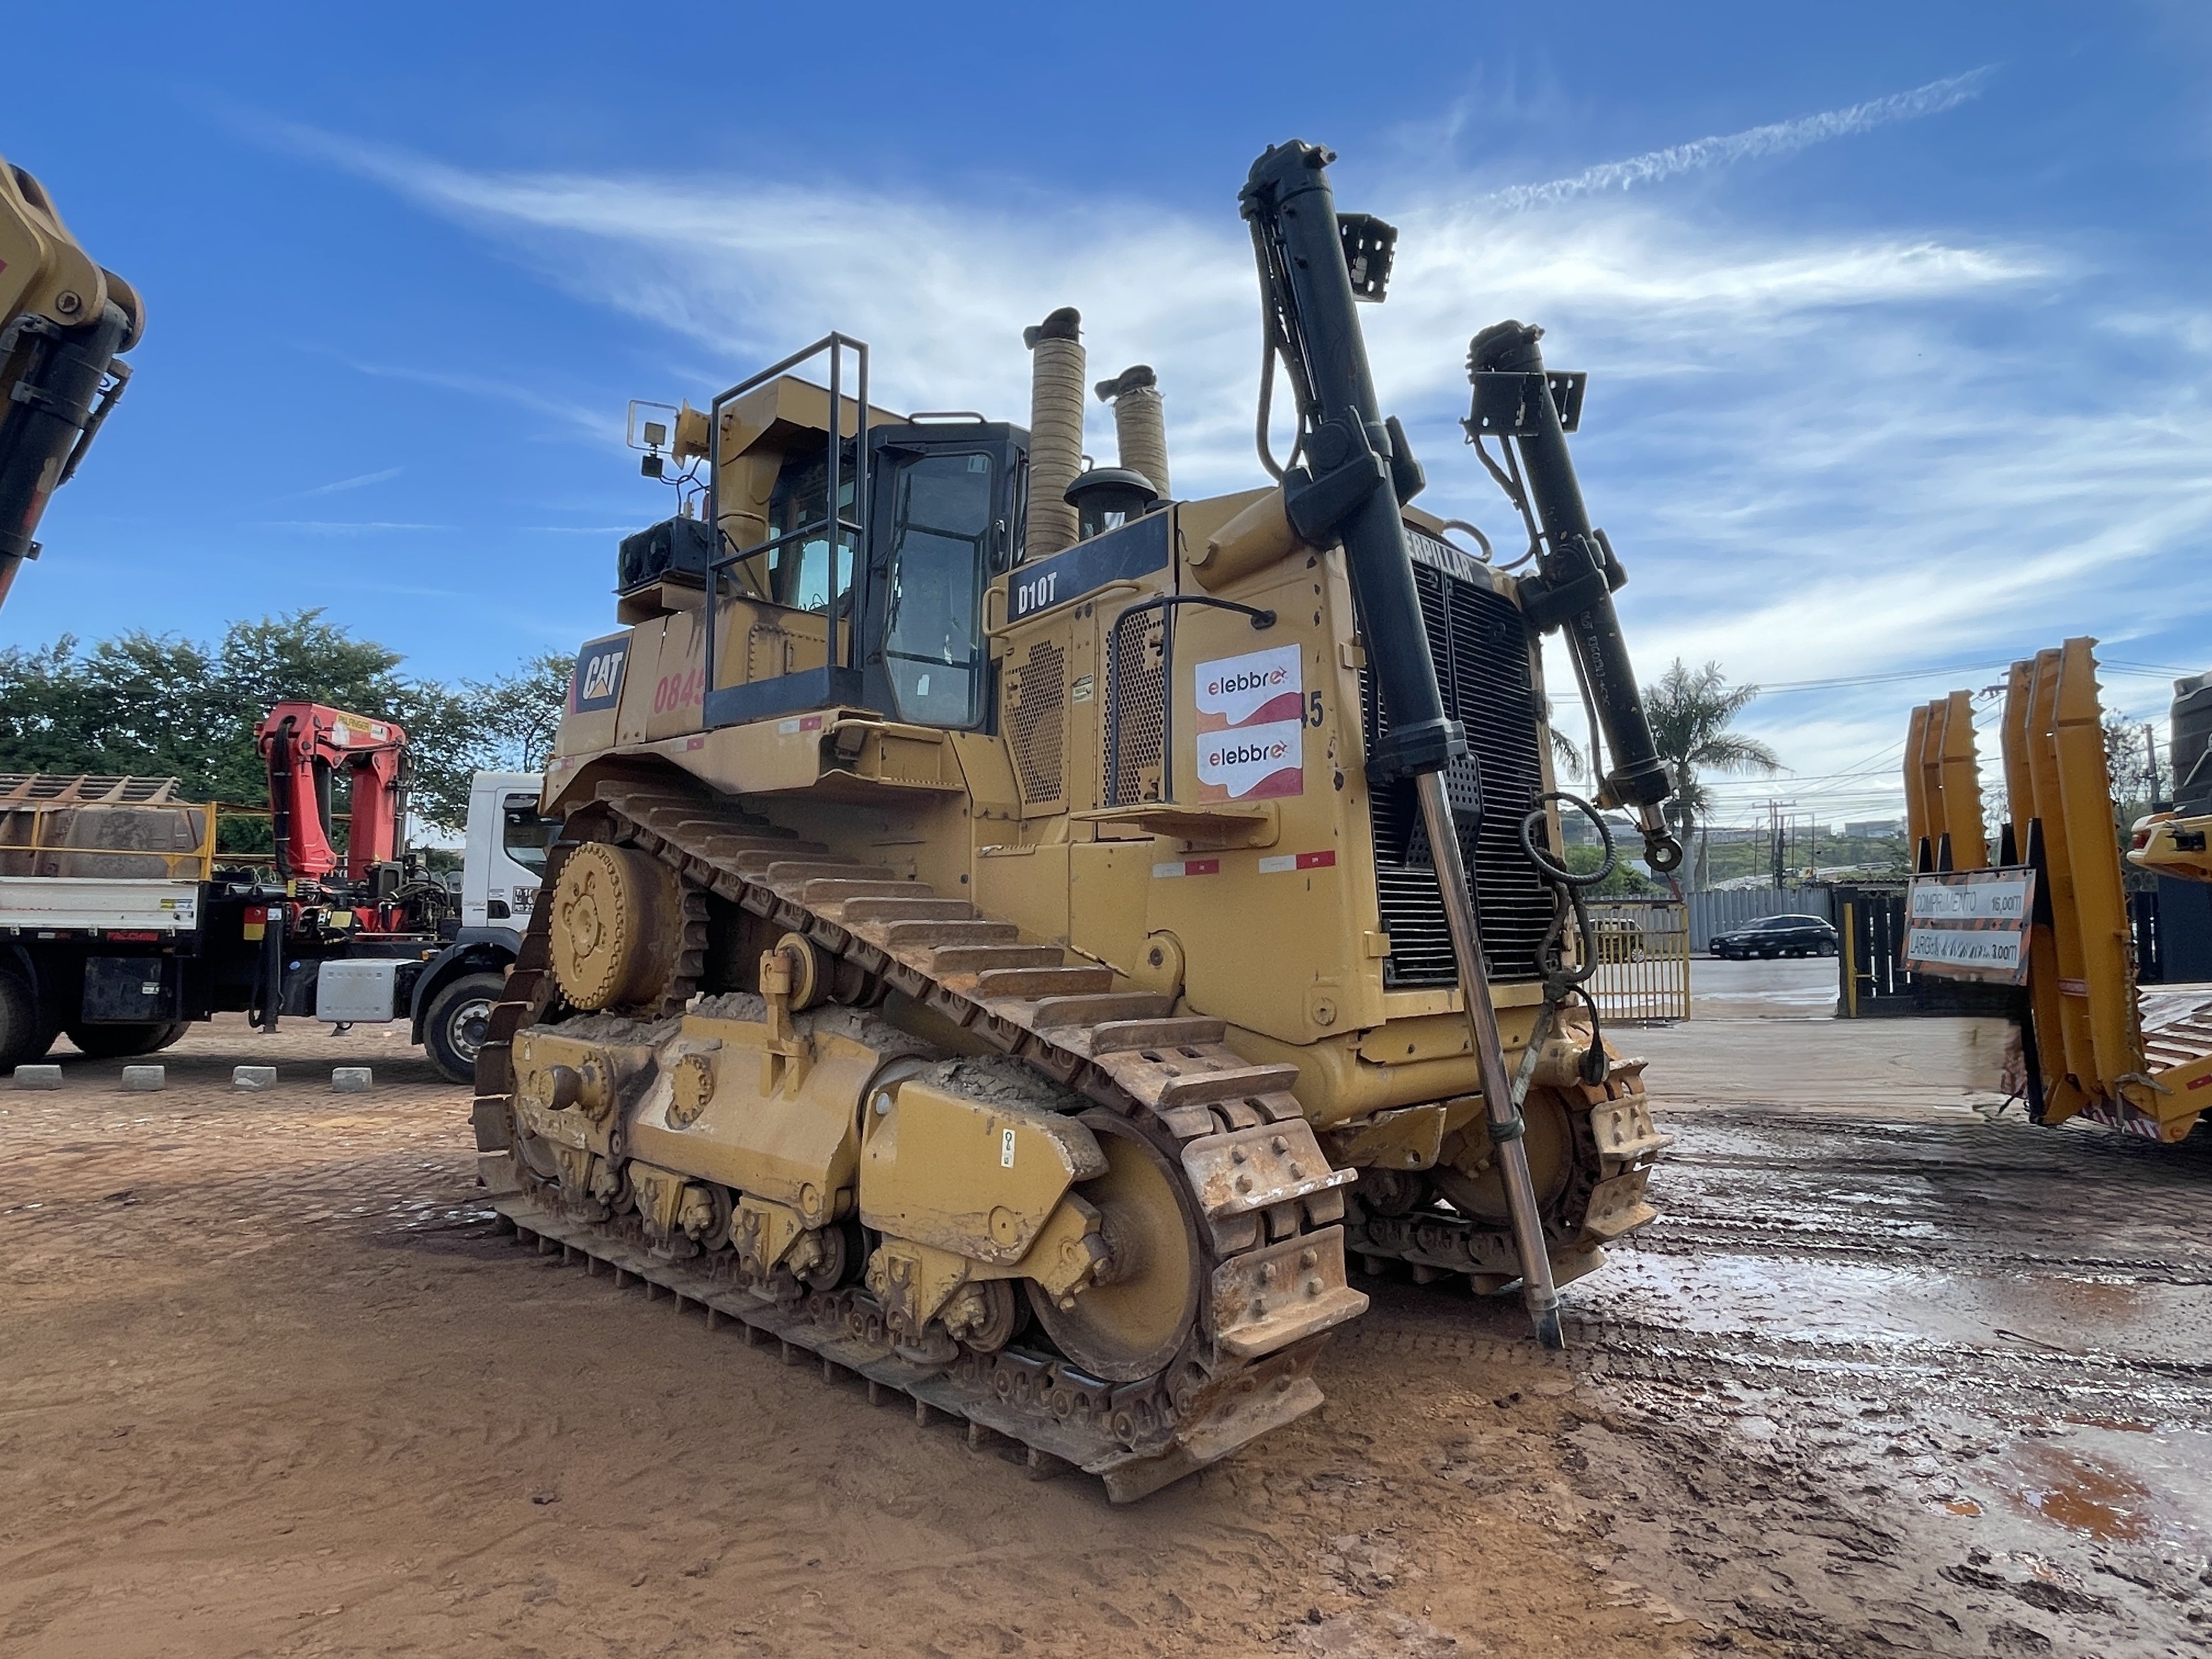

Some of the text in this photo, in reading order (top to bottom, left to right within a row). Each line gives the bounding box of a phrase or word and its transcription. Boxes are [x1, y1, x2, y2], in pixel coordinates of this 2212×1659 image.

[1404, 531, 1474, 583] ERPILLAR
[1018, 571, 1057, 615] D10T
[582, 652, 624, 699] CAT
[1209, 668, 1285, 695] elebbre
[1210, 743, 1285, 766] elebbre
